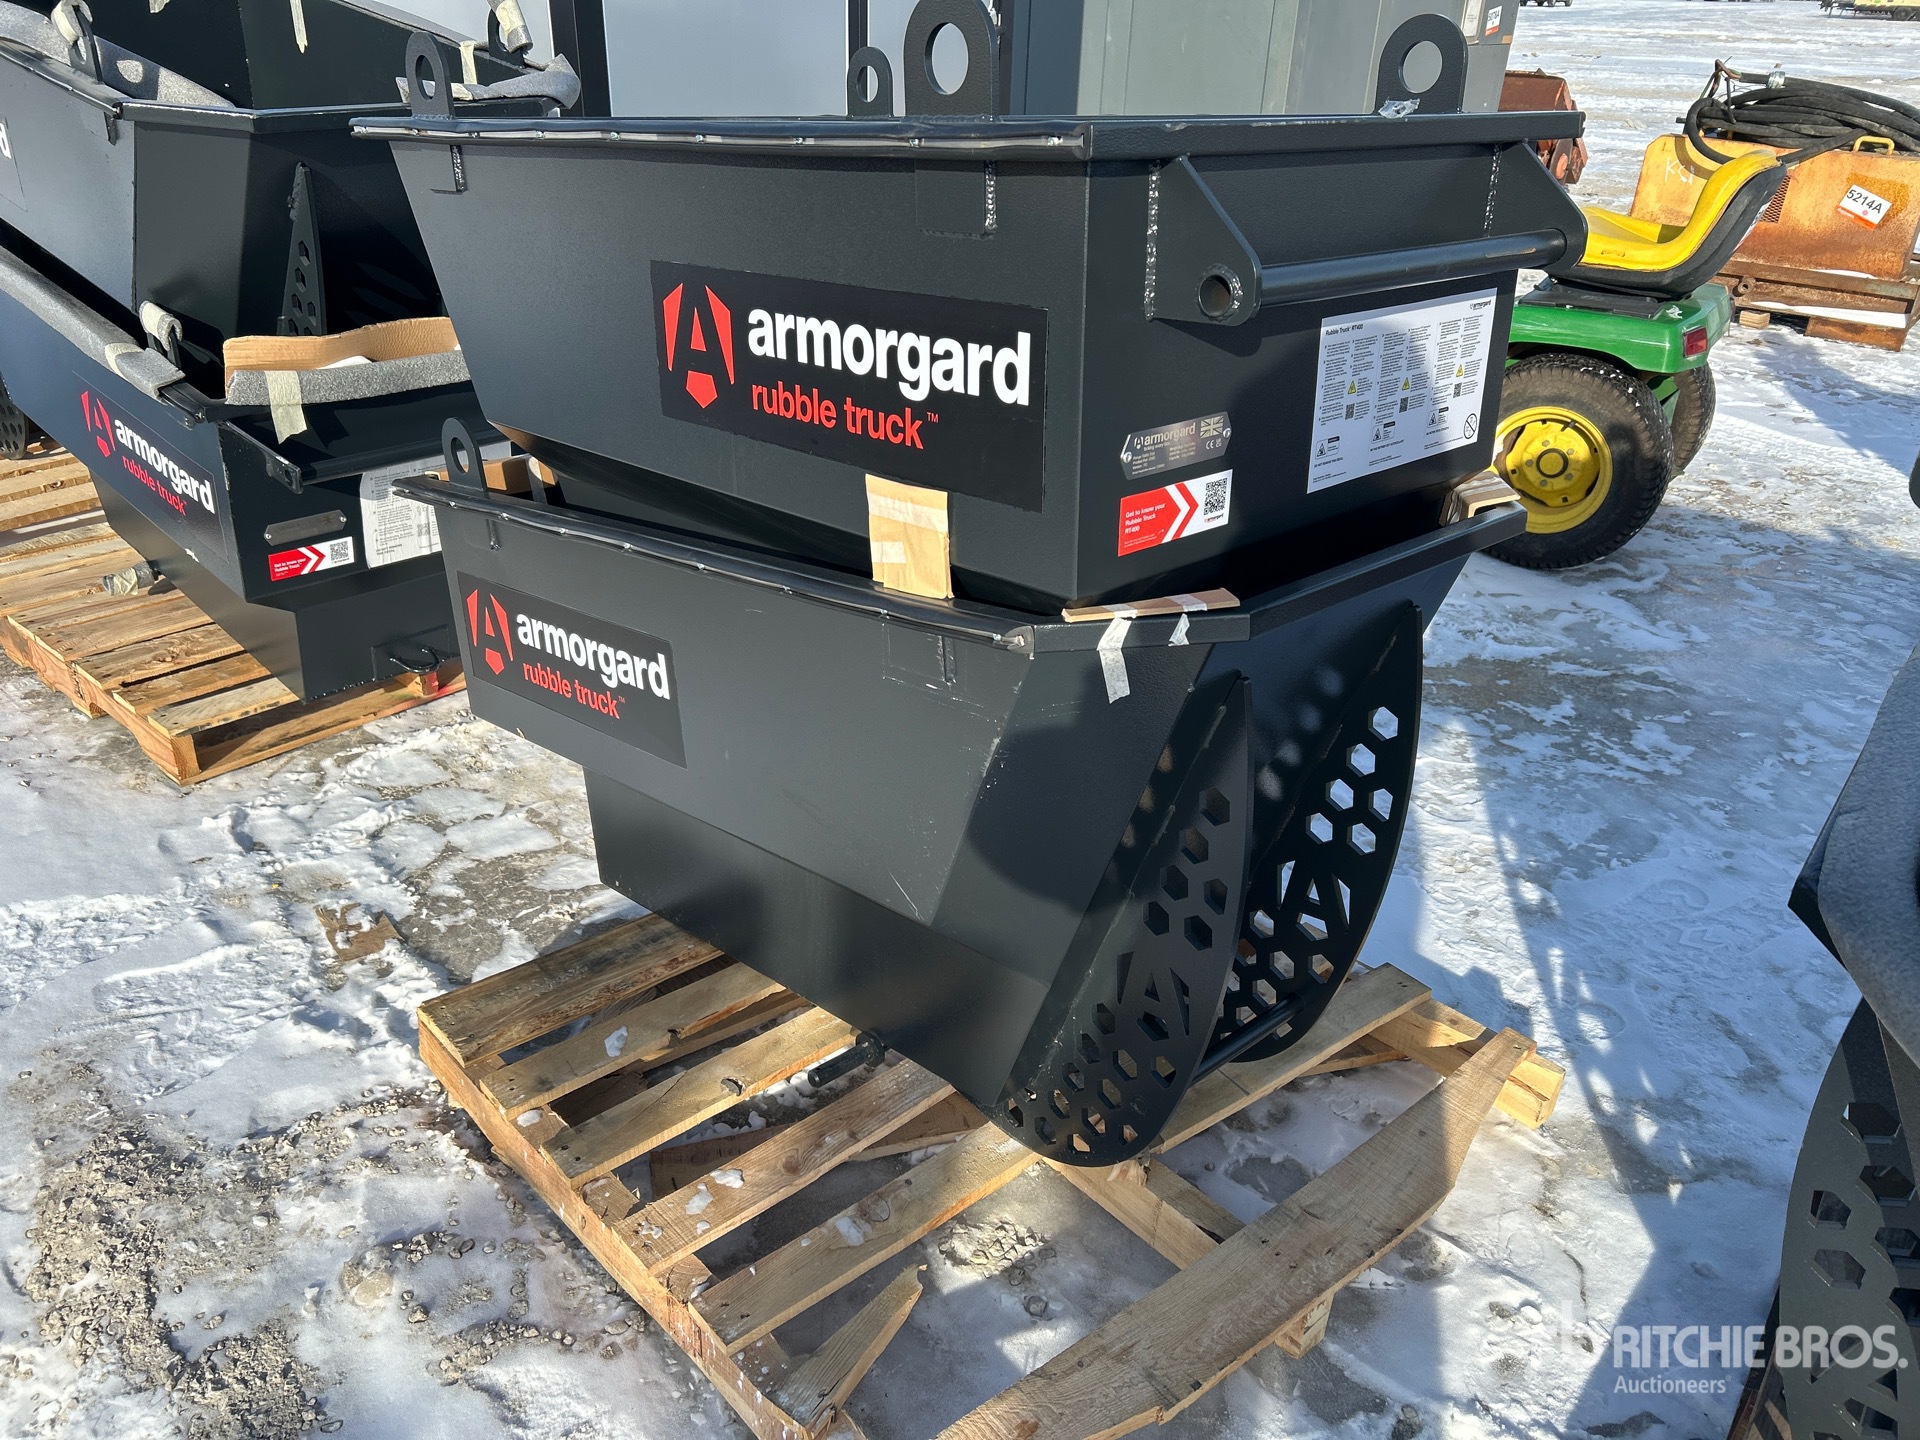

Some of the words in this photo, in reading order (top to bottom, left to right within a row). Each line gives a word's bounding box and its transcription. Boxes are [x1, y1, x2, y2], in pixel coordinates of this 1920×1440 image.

[1846, 189, 1882, 214] 5214A
[748, 308, 1030, 406] armorgard
[751, 381, 837, 428] rubble
[1144, 423, 1196, 445] armorgard
[114, 419, 216, 514] armorgard
[122, 455, 156, 492] rubble
[1125, 510, 1134, 518] Get
[1141, 506, 1154, 514] know
[1155, 503, 1166, 511] your
[1125, 517, 1142, 526] Rubble
[1143, 513, 1156, 521] Truck
[516, 613, 671, 701] armorgard
[522, 662, 572, 699] rubble
